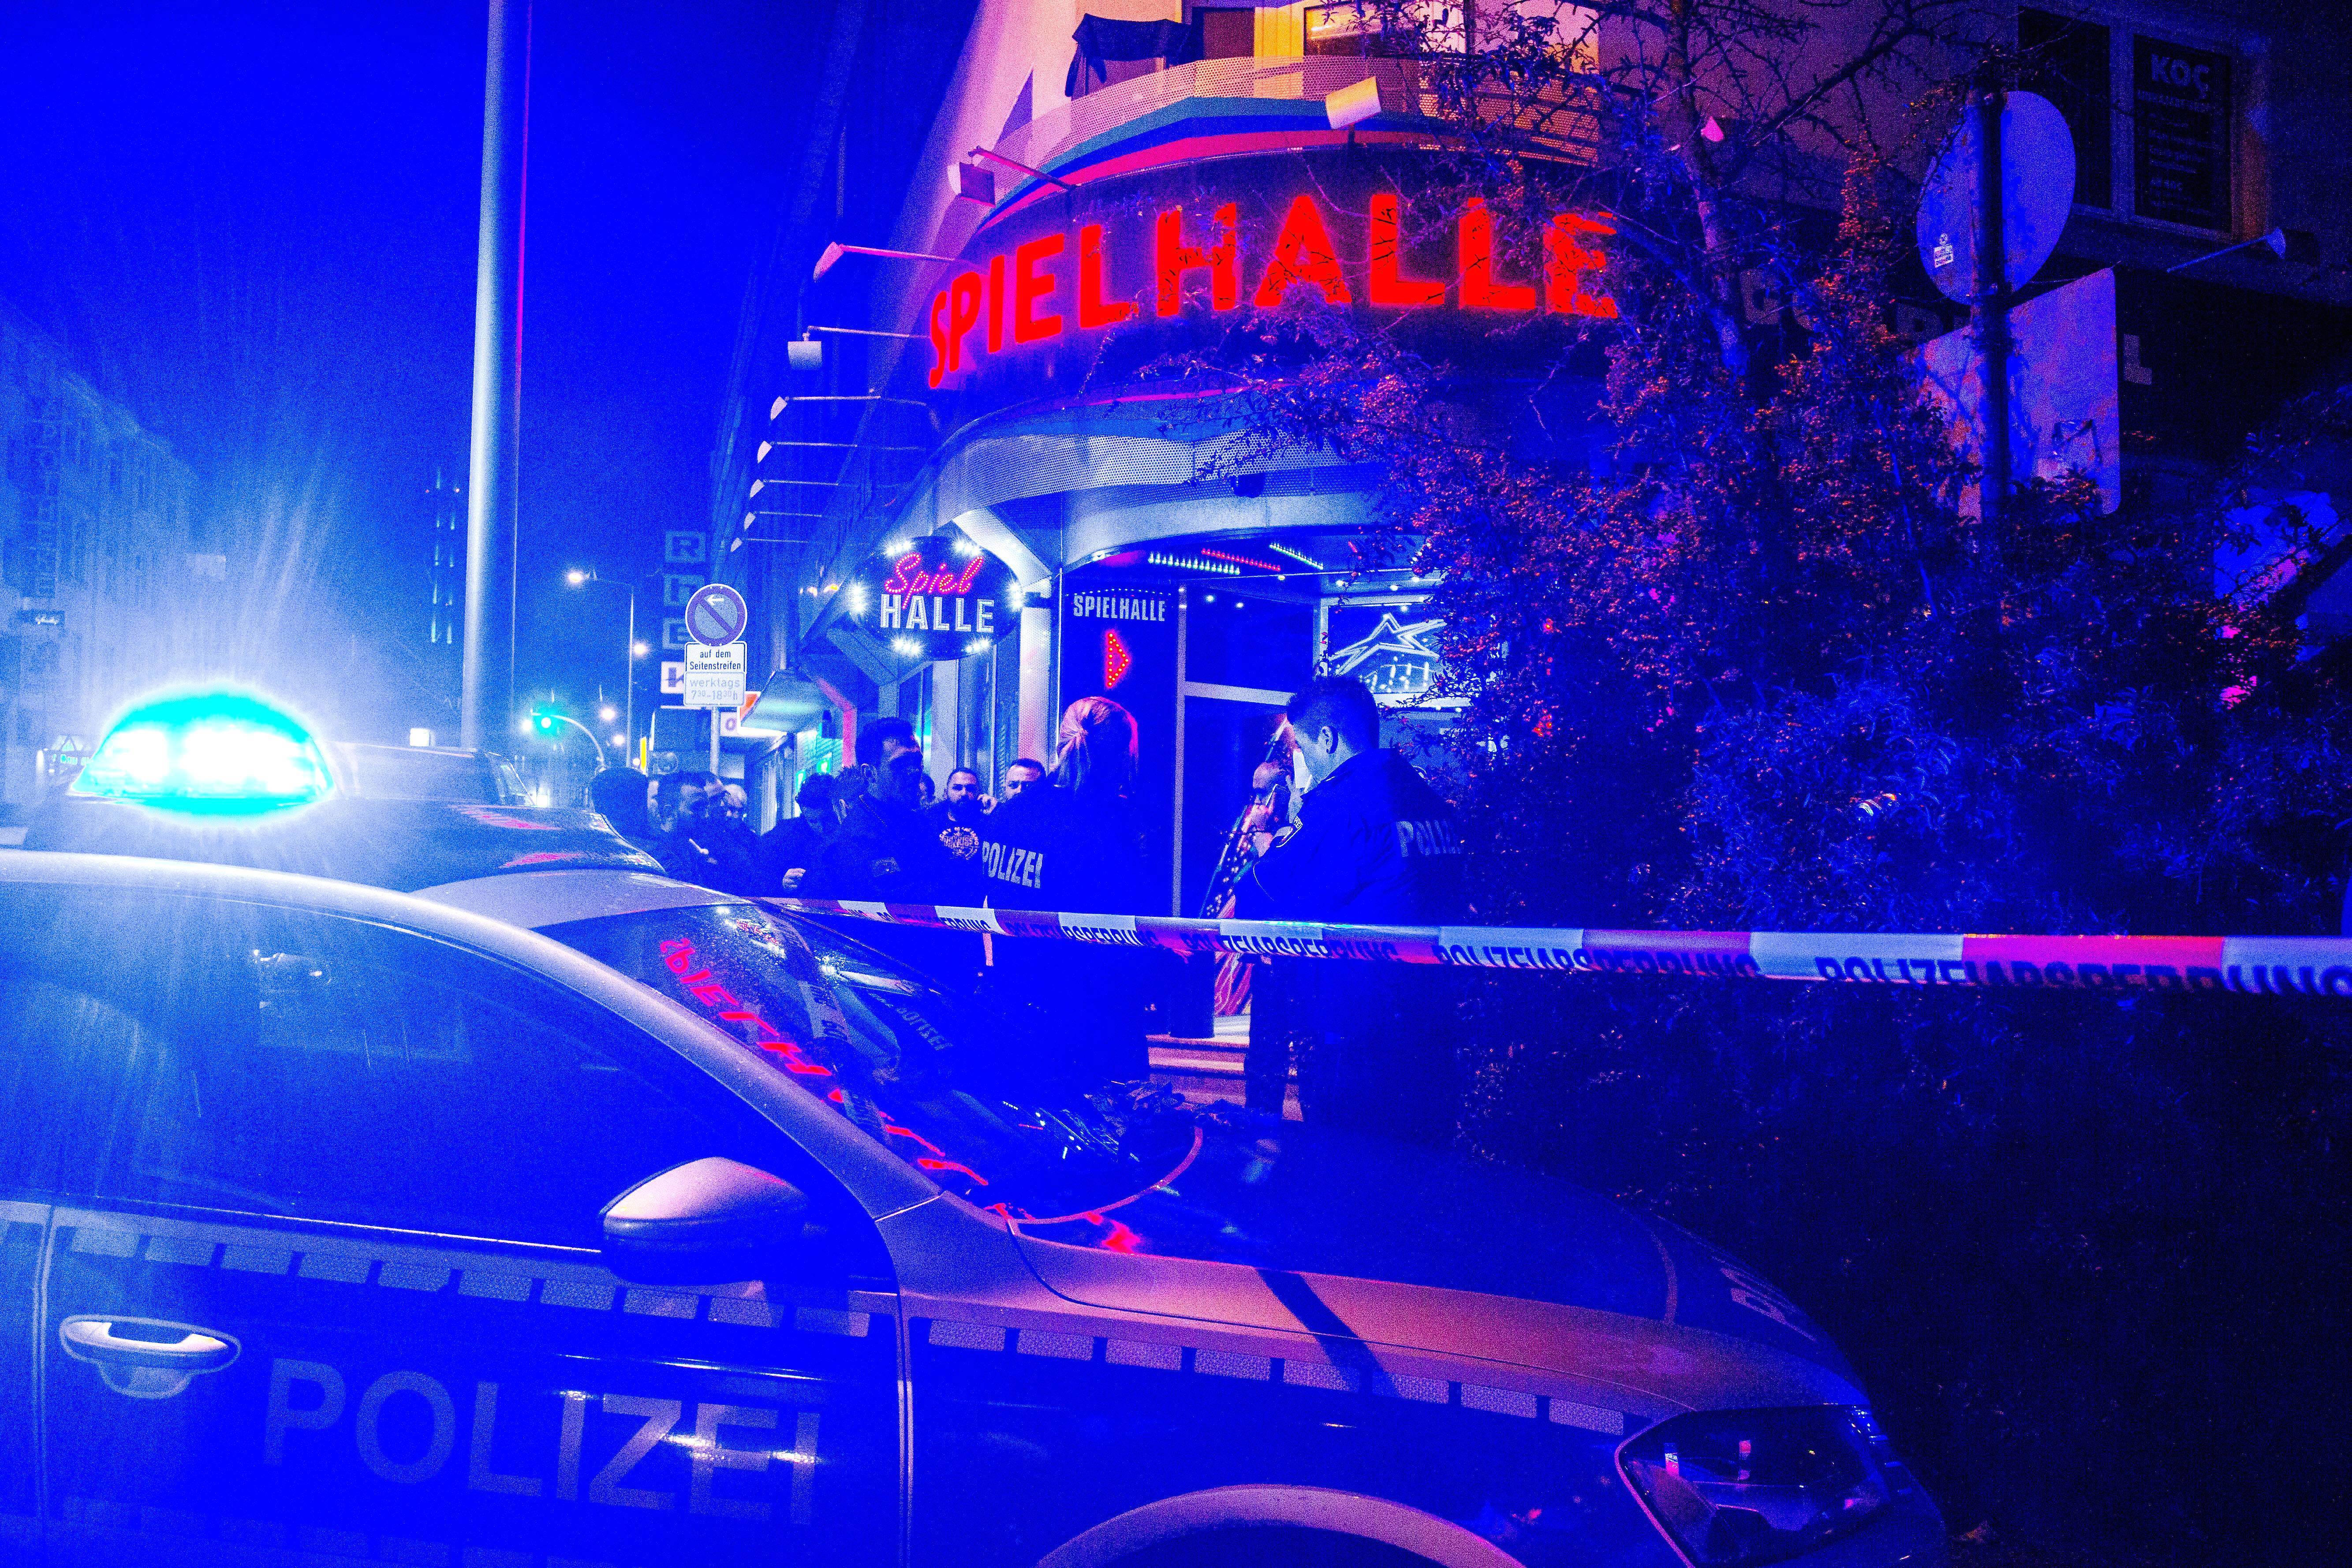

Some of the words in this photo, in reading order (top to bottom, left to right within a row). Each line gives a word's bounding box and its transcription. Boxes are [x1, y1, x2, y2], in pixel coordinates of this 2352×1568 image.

[929, 193, 1619, 390] SPIELHALLE
[884, 553, 983, 609] Spiel
[881, 594, 994, 633] HALLE
[1073, 594, 1165, 622] SPIELHALLE
[690, 661, 741, 670] Seitenstreifen
[700, 649, 711, 658] auf
[716, 649, 731, 657] dem
[690, 677, 740, 689] werktags
[982, 840, 1044, 889] POLIZEI
[264, 1357, 821, 1527] POLIZEI
